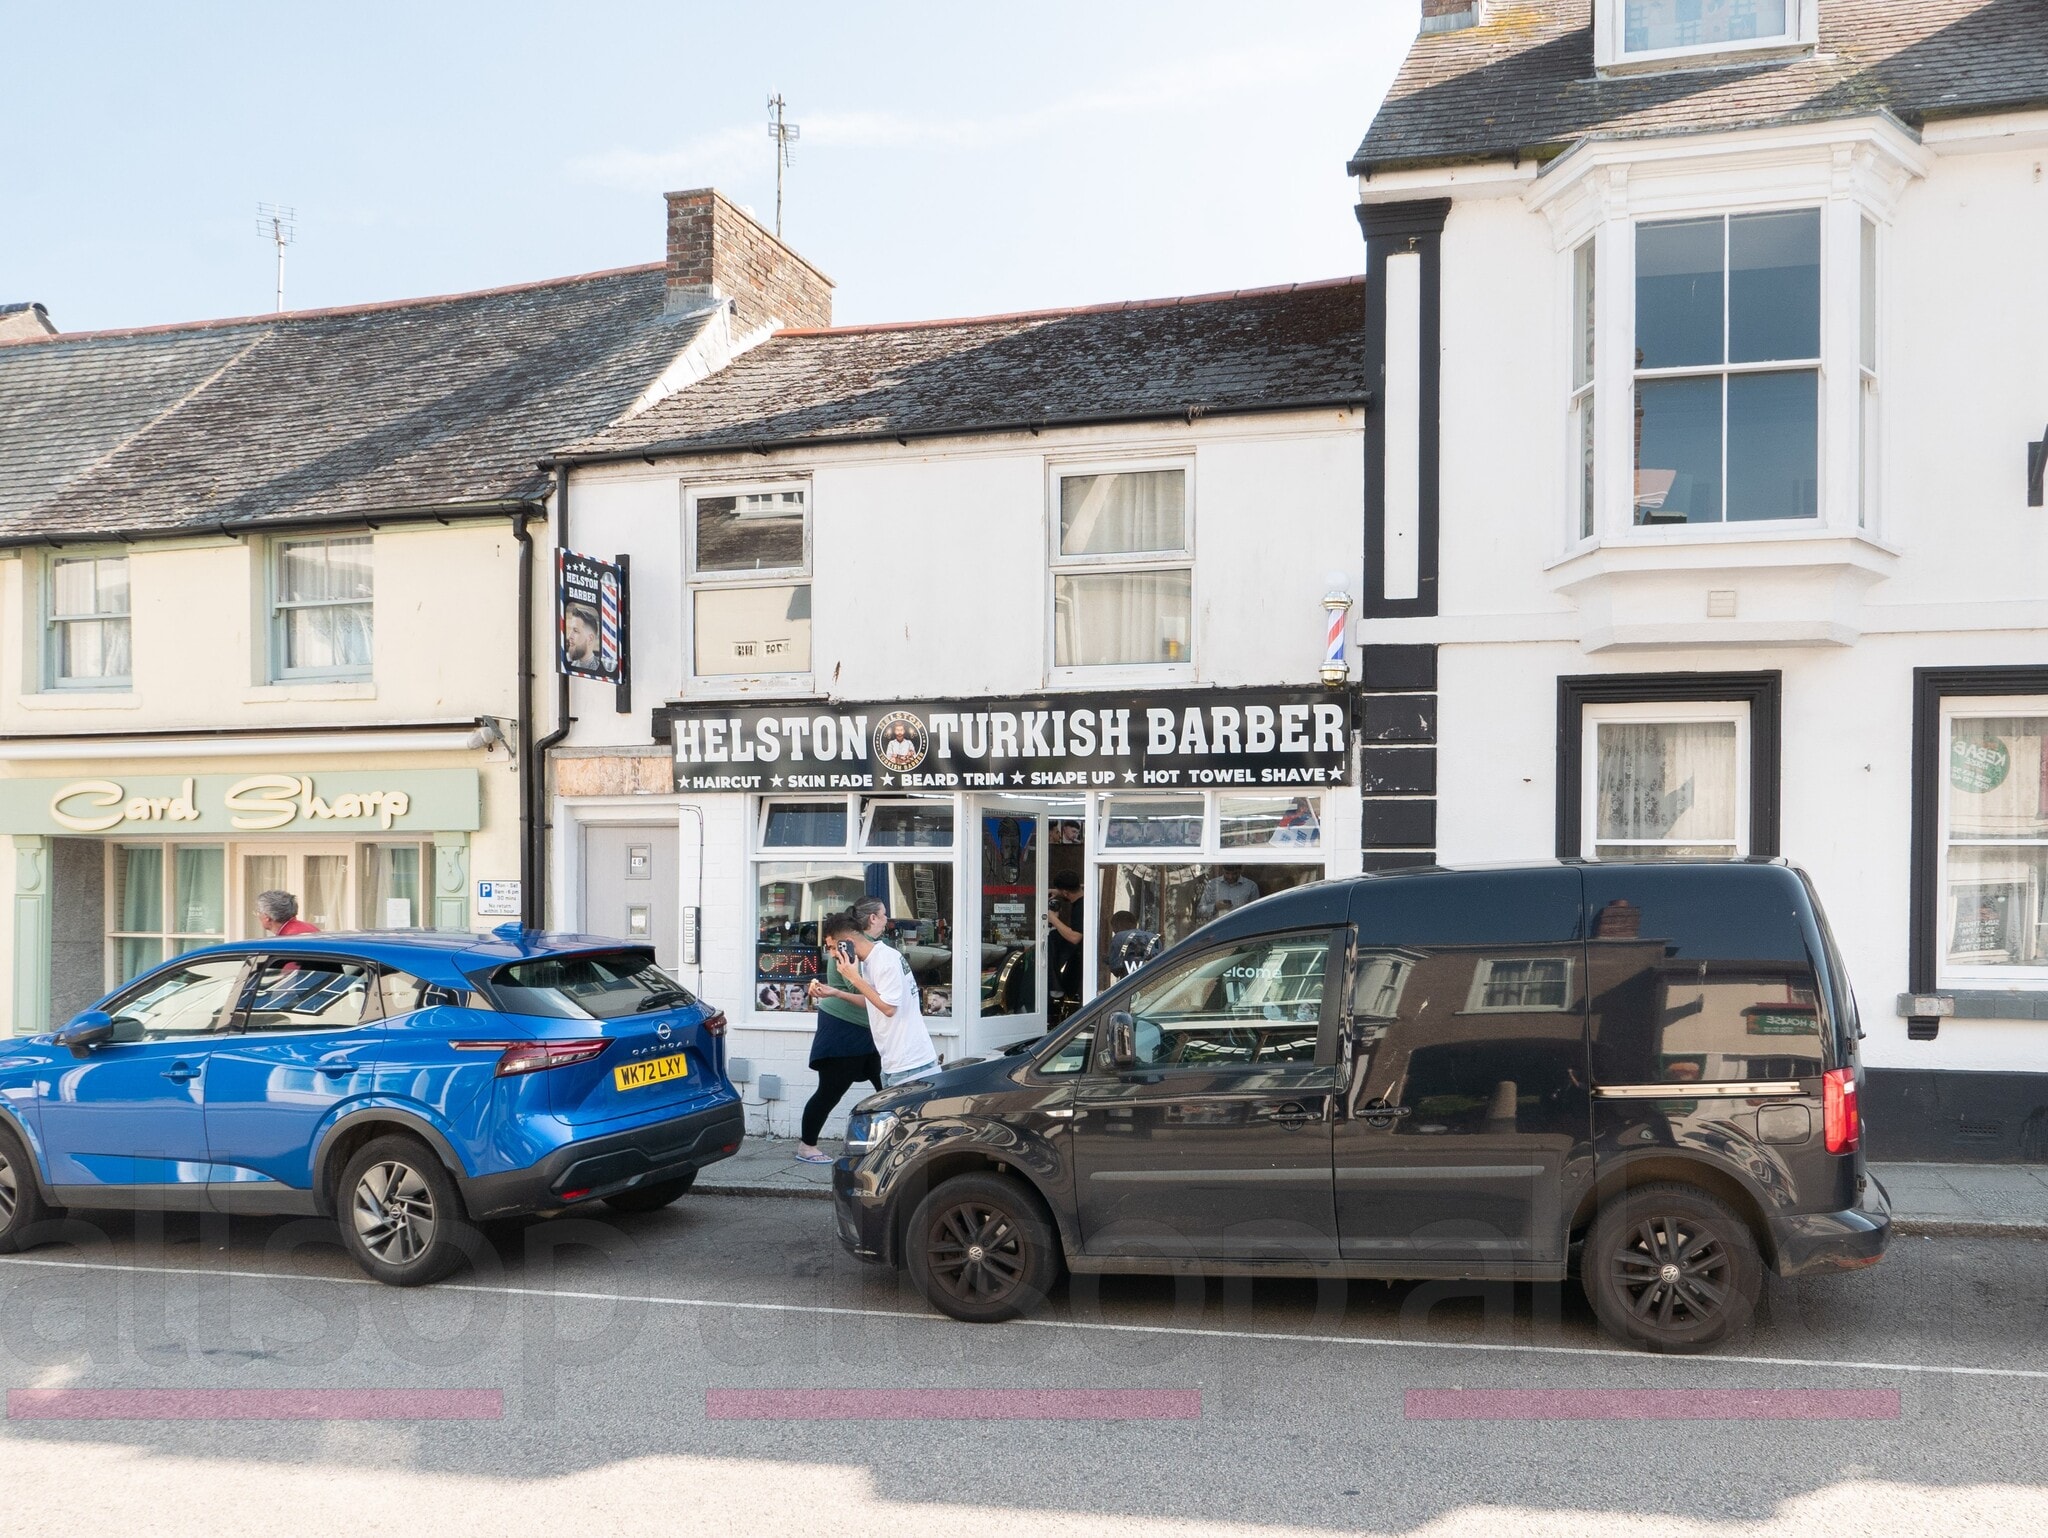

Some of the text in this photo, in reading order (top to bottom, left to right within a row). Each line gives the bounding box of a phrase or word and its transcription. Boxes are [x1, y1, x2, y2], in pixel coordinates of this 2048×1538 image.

[566, 572, 599, 590] HELSTON
[568, 586, 597, 604] BARBER
[879, 712, 923, 730] HELSTON
[674, 704, 1345, 763] HELSTON TURKISH BARBER
[693, 768, 1325, 788] HAIRCUT SKIN FADE BEARD TRIM SHAPE UP HOT TOWEL SHAVE
[50, 774, 409, 831] Card Sharp
[759, 953, 817, 974] OPEN
[1222, 966, 1282, 978] elcome
[621, 1058, 680, 1086] WK72 LXY
